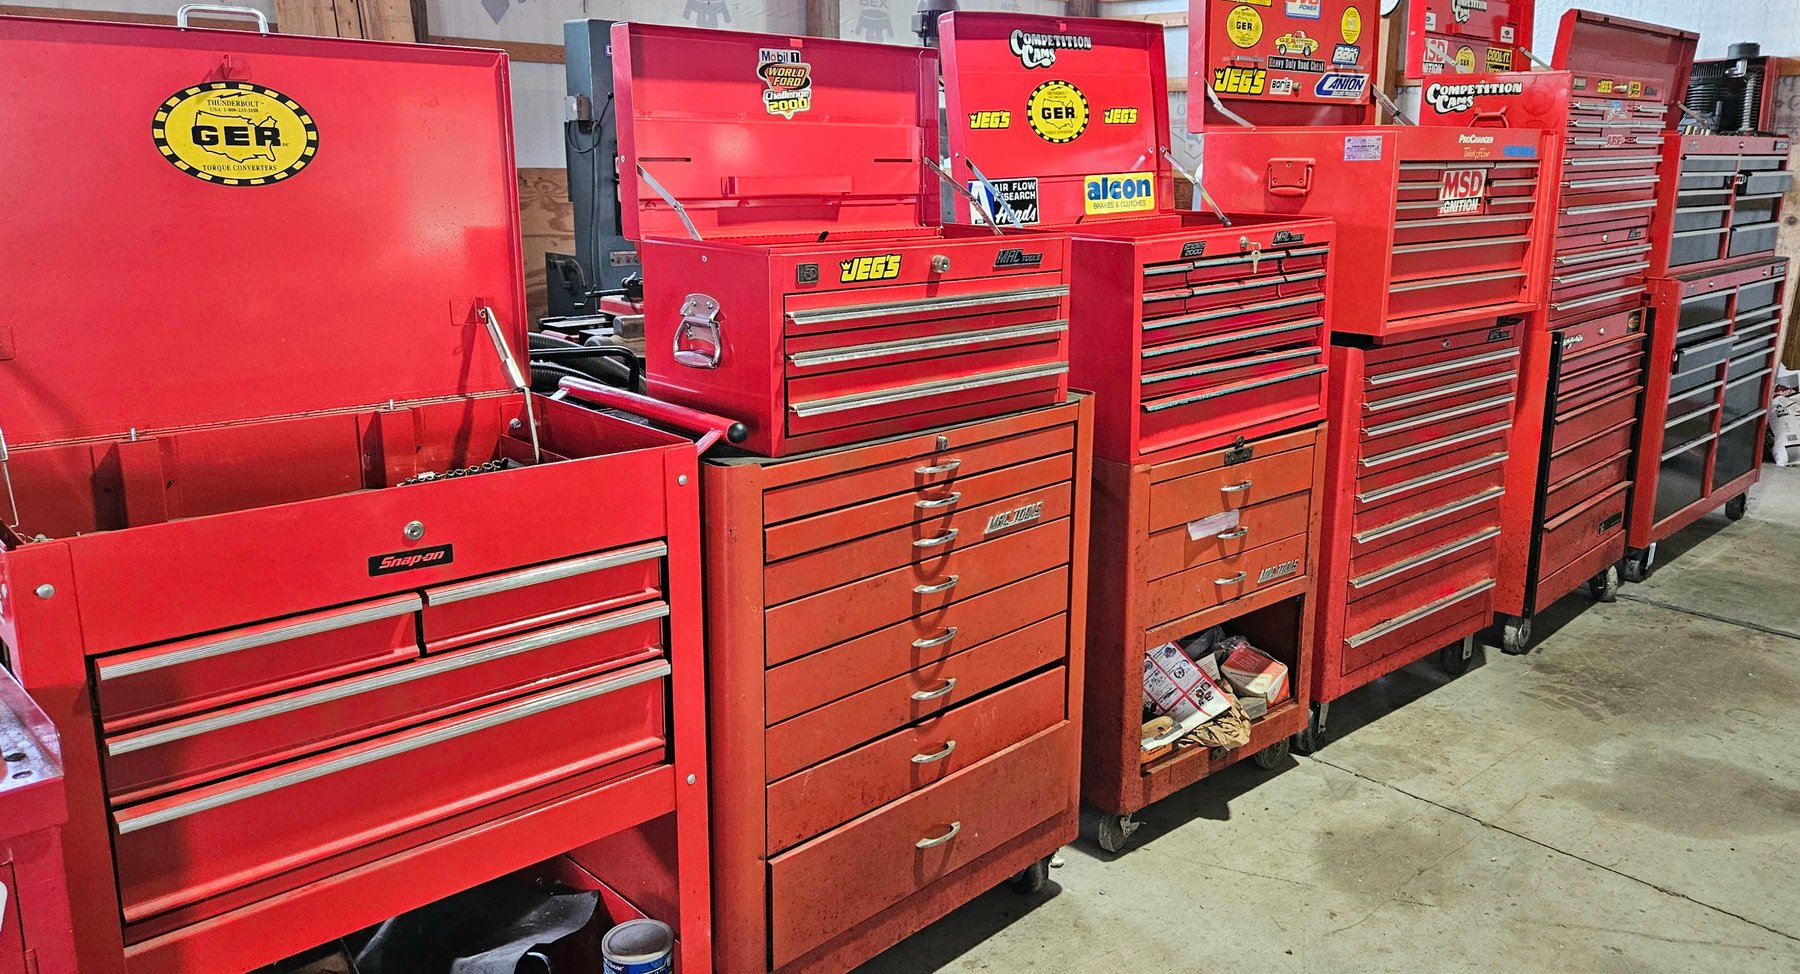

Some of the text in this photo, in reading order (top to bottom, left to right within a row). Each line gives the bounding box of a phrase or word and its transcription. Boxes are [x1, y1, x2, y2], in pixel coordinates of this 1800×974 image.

[1236, 22, 1253, 31] GER
[1010, 29, 1092, 55] COMPETITION
[761, 51, 800, 63] Mobil 1
[1021, 44, 1056, 68] CAMS
[768, 67, 806, 78] WORLD
[773, 76, 803, 87] FORD
[1214, 68, 1266, 95] JEG'S
[1316, 74, 1365, 95] CANTON
[765, 90, 810, 100] Challenge
[1426, 83, 1523, 104] COMPETITION
[207, 99, 259, 107] THUNDERBOLT
[769, 98, 808, 112] 2000
[1436, 95, 1474, 113] CAMS
[970, 110, 1011, 129] JEG'S
[1041, 106, 1075, 119] GER
[1104, 108, 1138, 124] JEG'S
[191, 125, 281, 146] GER
[203, 164, 232, 172] TORQUE
[994, 182, 1036, 191] AIR FLOW
[1087, 177, 1151, 200] alcon
[1442, 171, 1483, 198] MSD
[1275, 231, 1291, 243] MAC
[996, 249, 1041, 264] MAC TOOLS
[1185, 248, 1203, 256] 2000
[841, 255, 901, 282] JEG'S
[985, 502, 1042, 532] MAC TOOLS
[379, 551, 445, 569] Snap-on
